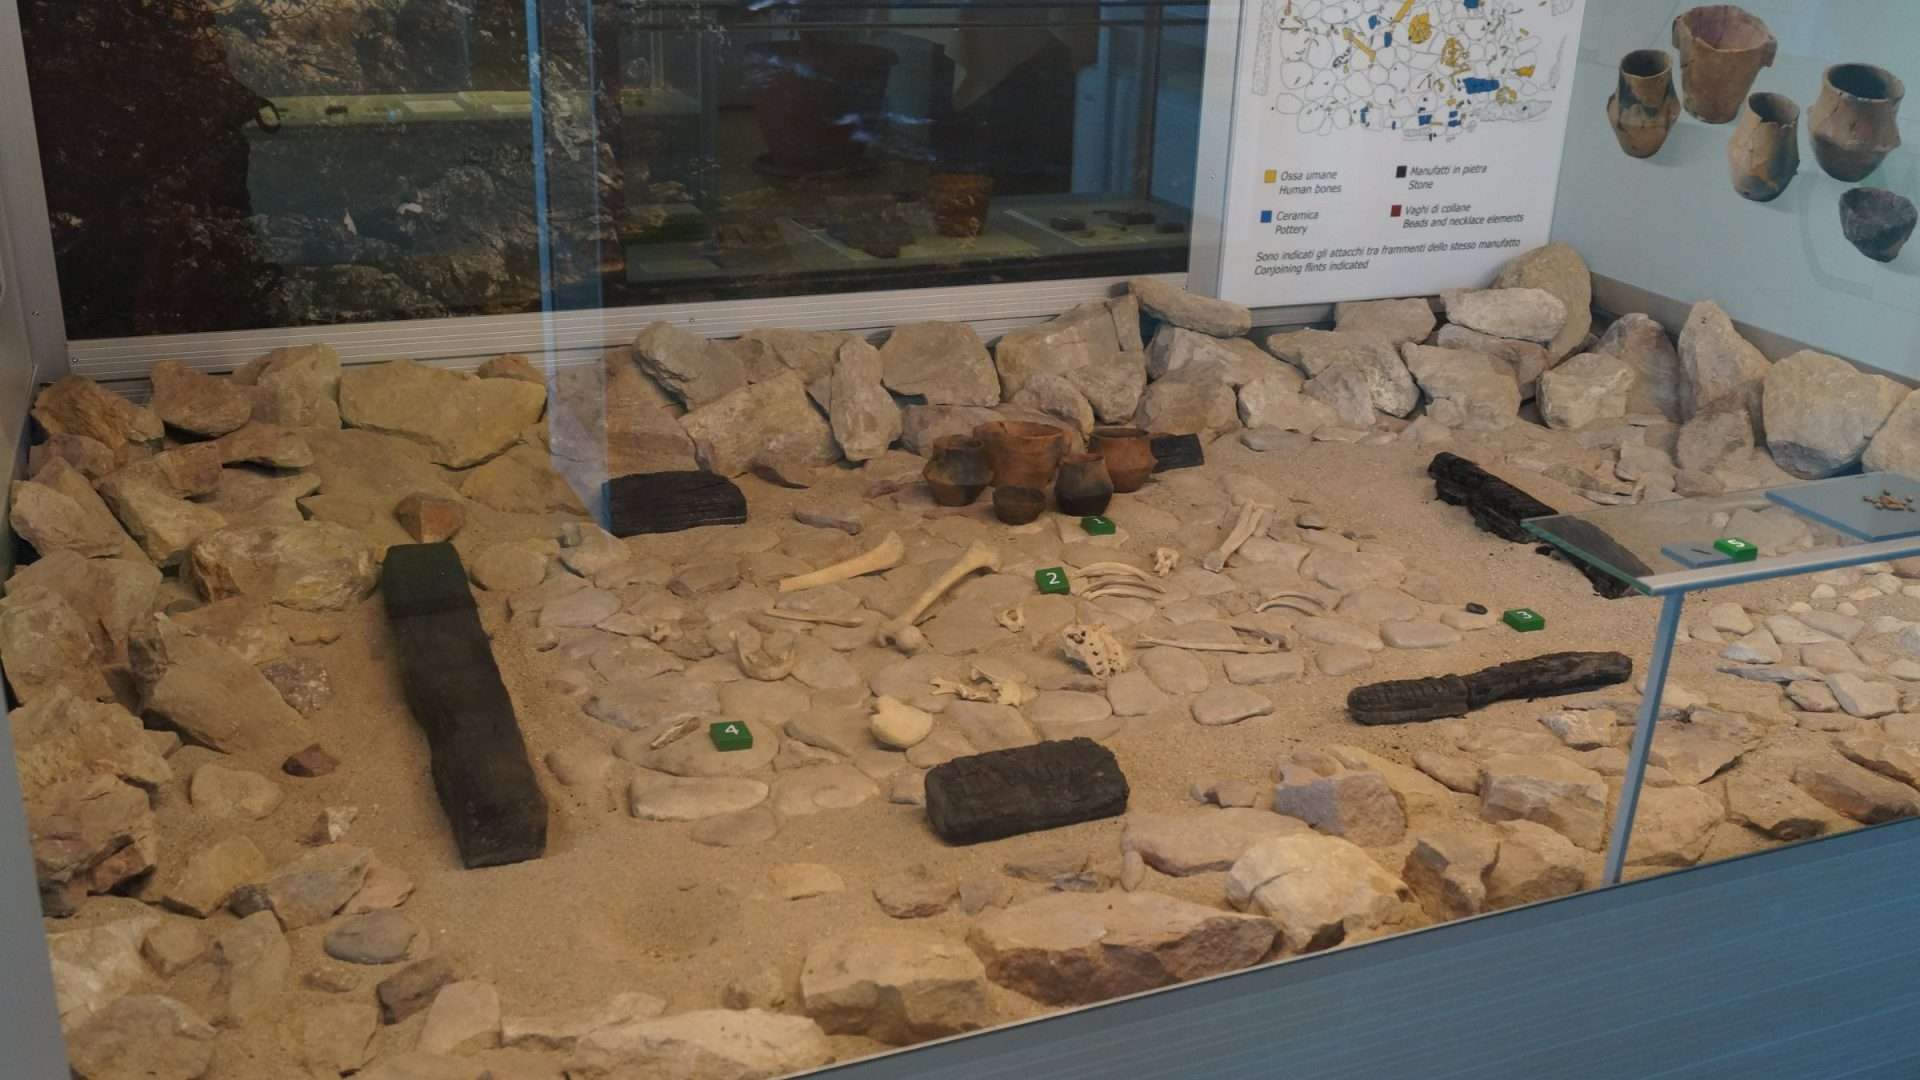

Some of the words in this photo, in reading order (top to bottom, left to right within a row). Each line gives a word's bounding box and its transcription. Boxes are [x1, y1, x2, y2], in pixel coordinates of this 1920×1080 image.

[1410, 165, 1450, 176] Manufatti
[1462, 164, 1488, 175] pietra
[1280, 171, 1303, 181] Ossa
[1306, 171, 1338, 180] umane
[1279, 185, 1313, 195] Human
[1314, 184, 1342, 194] bones
[1408, 180, 1434, 190] Stone
[1405, 205, 1429, 216] Vaghi
[1440, 203, 1471, 213] collane
[1276, 211, 1320, 221] Ceramica
[1403, 218, 1429, 228] Beads
[1430, 217, 1448, 227] and
[1449, 215, 1485, 226] necklace
[1486, 214, 1525, 224] elements
[1275, 225, 1308, 236] Pottery
[1256, 252, 1280, 262] Sono
[1282, 250, 1314, 260] indicati
[1329, 246, 1365, 257] attacchi
[1366, 246, 1380, 256] tra
[1381, 244, 1426, 255] frammenti
[1427, 242, 1449, 252] dello
[1450, 242, 1477, 251] stesso
[1479, 238, 1521, 248] manufatto
[1254, 264, 1302, 276] Conjoining
[1304, 262, 1327, 273] flints
[1329, 259, 1370, 271] indicated
[1046, 572, 1061, 585] 2
[1516, 611, 1533, 619] 3
[724, 724, 740, 735] 4
